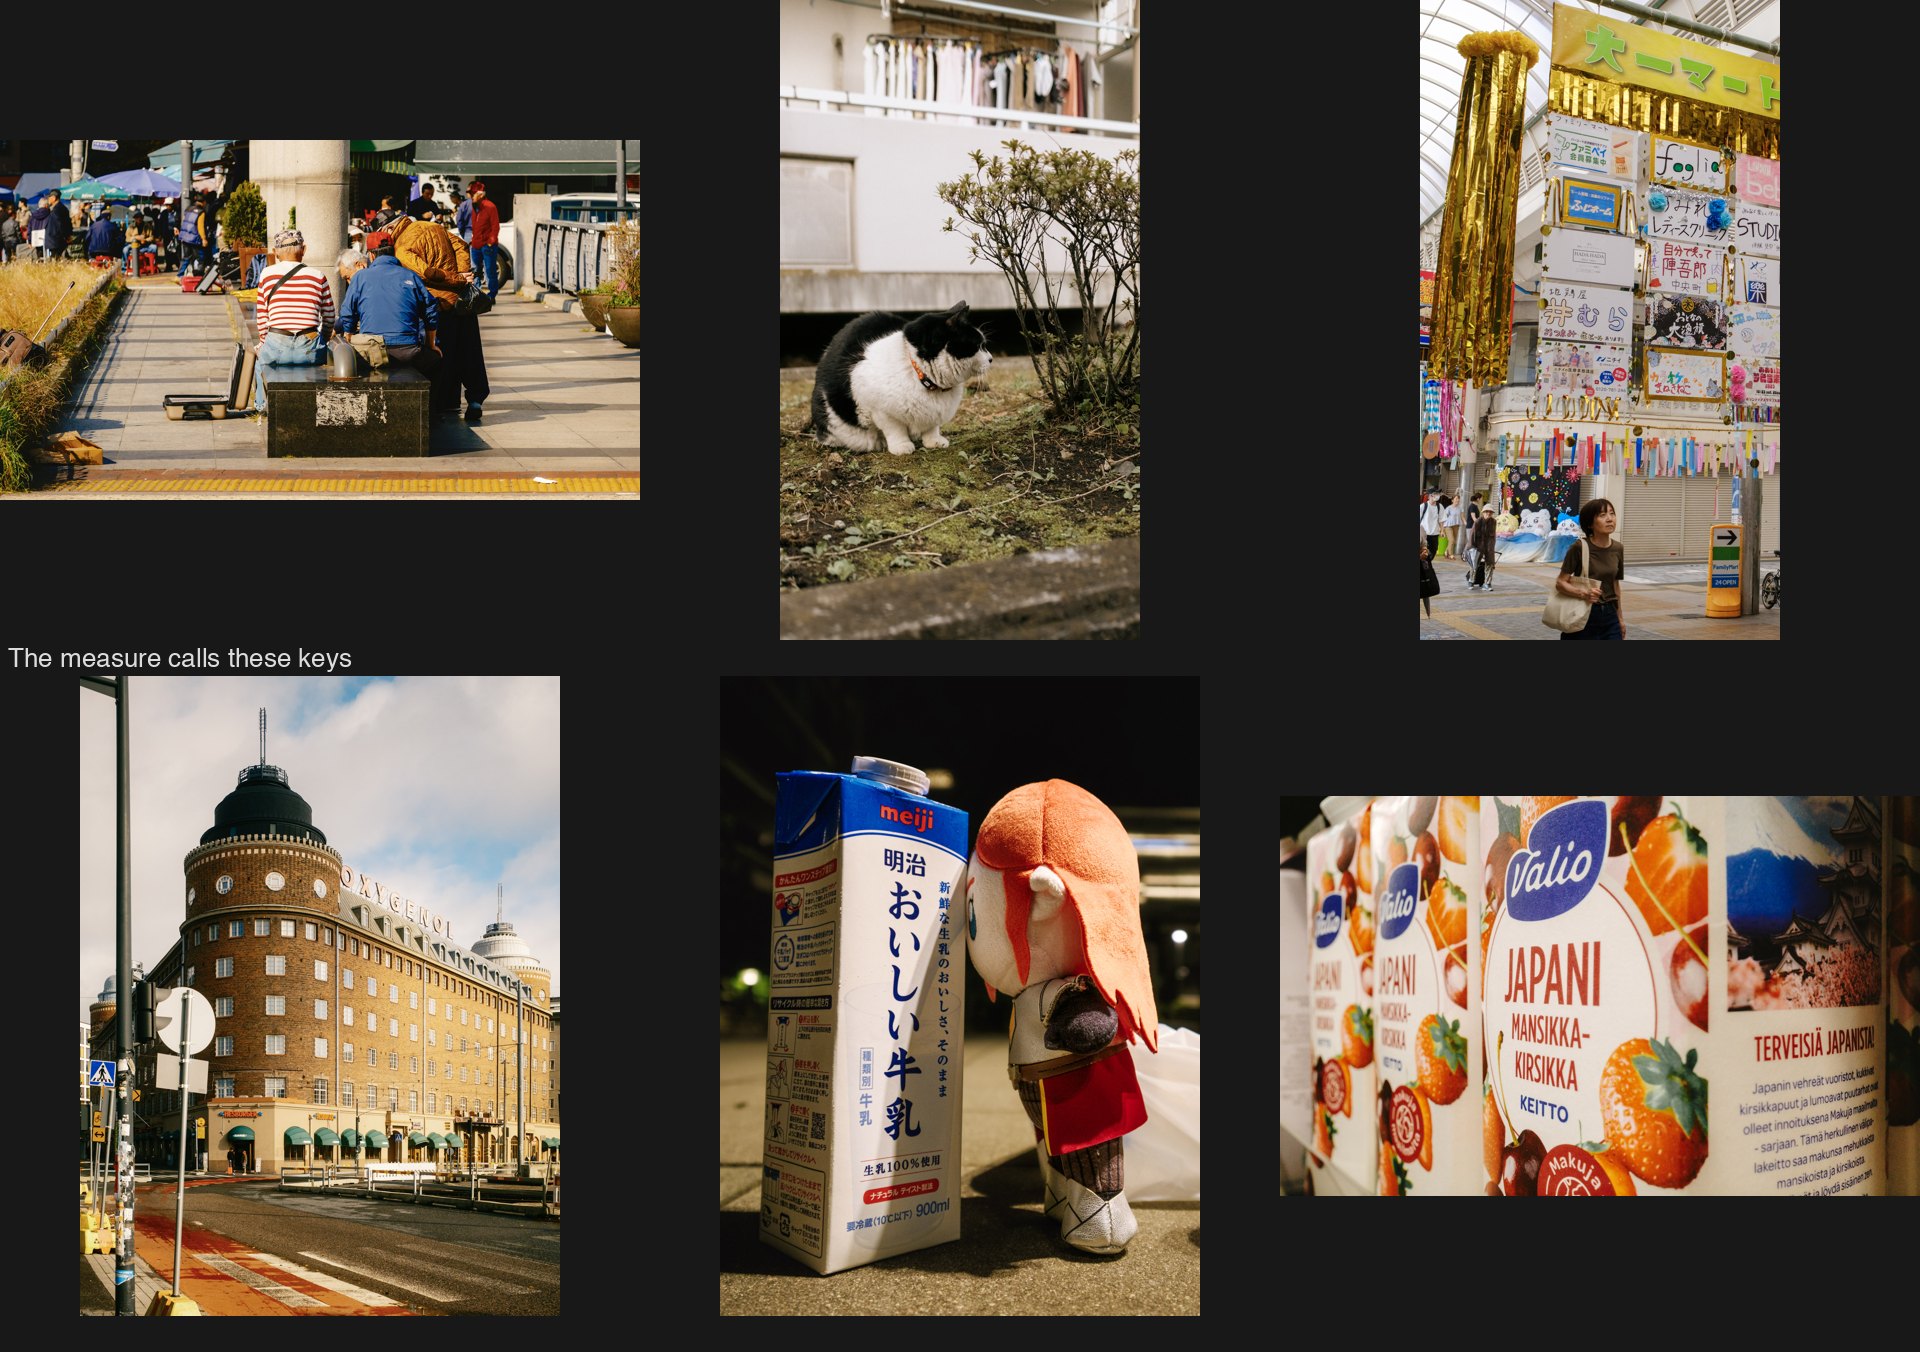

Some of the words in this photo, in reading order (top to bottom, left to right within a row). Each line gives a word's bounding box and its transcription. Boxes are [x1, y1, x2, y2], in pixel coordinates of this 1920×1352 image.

[1569, 152, 1607, 167] 会員募集中
[1570, 142, 1607, 158] ファミペイ
[1656, 143, 1723, 181] foglia
[1570, 199, 1613, 216] ふじホーム
[1652, 215, 1727, 241] レディースクリニック
[1737, 217, 1780, 242] STUDI
[1662, 258, 1707, 279] 陣吾郎
[1671, 280, 1701, 294] 中央町
[1543, 297, 1628, 332] 井むら
[879, 804, 935, 833] meiji
[883, 848, 927, 878] 明治
[1510, 840, 1593, 899] Valio
[340, 864, 454, 941] OXYGENOL
[1380, 888, 1414, 925] Valio
[1504, 941, 1601, 1007] JAPANI
[937, 880, 951, 1098] 新鮮な生乳のおいしさ、そのまま
[883, 880, 922, 1141] おいしい牛乳
[1511, 1012, 1590, 1049] MANSIKKA-
[1754, 1027, 1824, 1063] TERVEISIÄ
[1826, 1025, 1876, 1055] JAPANISTA!
[862, 1050, 872, 1087] 種類別
[1515, 1050, 1579, 1092] KIRSIKKA
[1752, 1079, 1791, 1096] Japanin
[1793, 1076, 1825, 1090] vehreät
[1825, 1069, 1856, 1085] vuoristot,
[859, 1093, 873, 1127] 牛乳
[1520, 1094, 1569, 1123] KEITTO
[1739, 1099, 1799, 1116] kirsikkapuut
[1800, 1097, 1809, 1111] ja
[1809, 1091, 1844, 1106] lumoavat
[1743, 1121, 1772, 1136] olleet
[1774, 1113, 1829, 1131] innoituksena
[1830, 1107, 1853, 1122] Makuja
[1761, 1137, 1798, 1155] sarjaan.
[1800, 1131, 1824, 1146] Tämä
[1824, 1124, 1860, 1141] herkullinen
[863, 1154, 941, 1177] 生乳100%使用
[1548, 1151, 1602, 1191] Makuja
[1754, 1159, 1791, 1174] lakeitto
[1793, 1155, 1808, 1166] saa
[1809, 1147, 1843, 1163] makunsa
[1776, 1170, 1829, 1190] mansikoista
[1829, 1167, 1837, 1180] ja
[916, 1197, 950, 1218] 900ml
